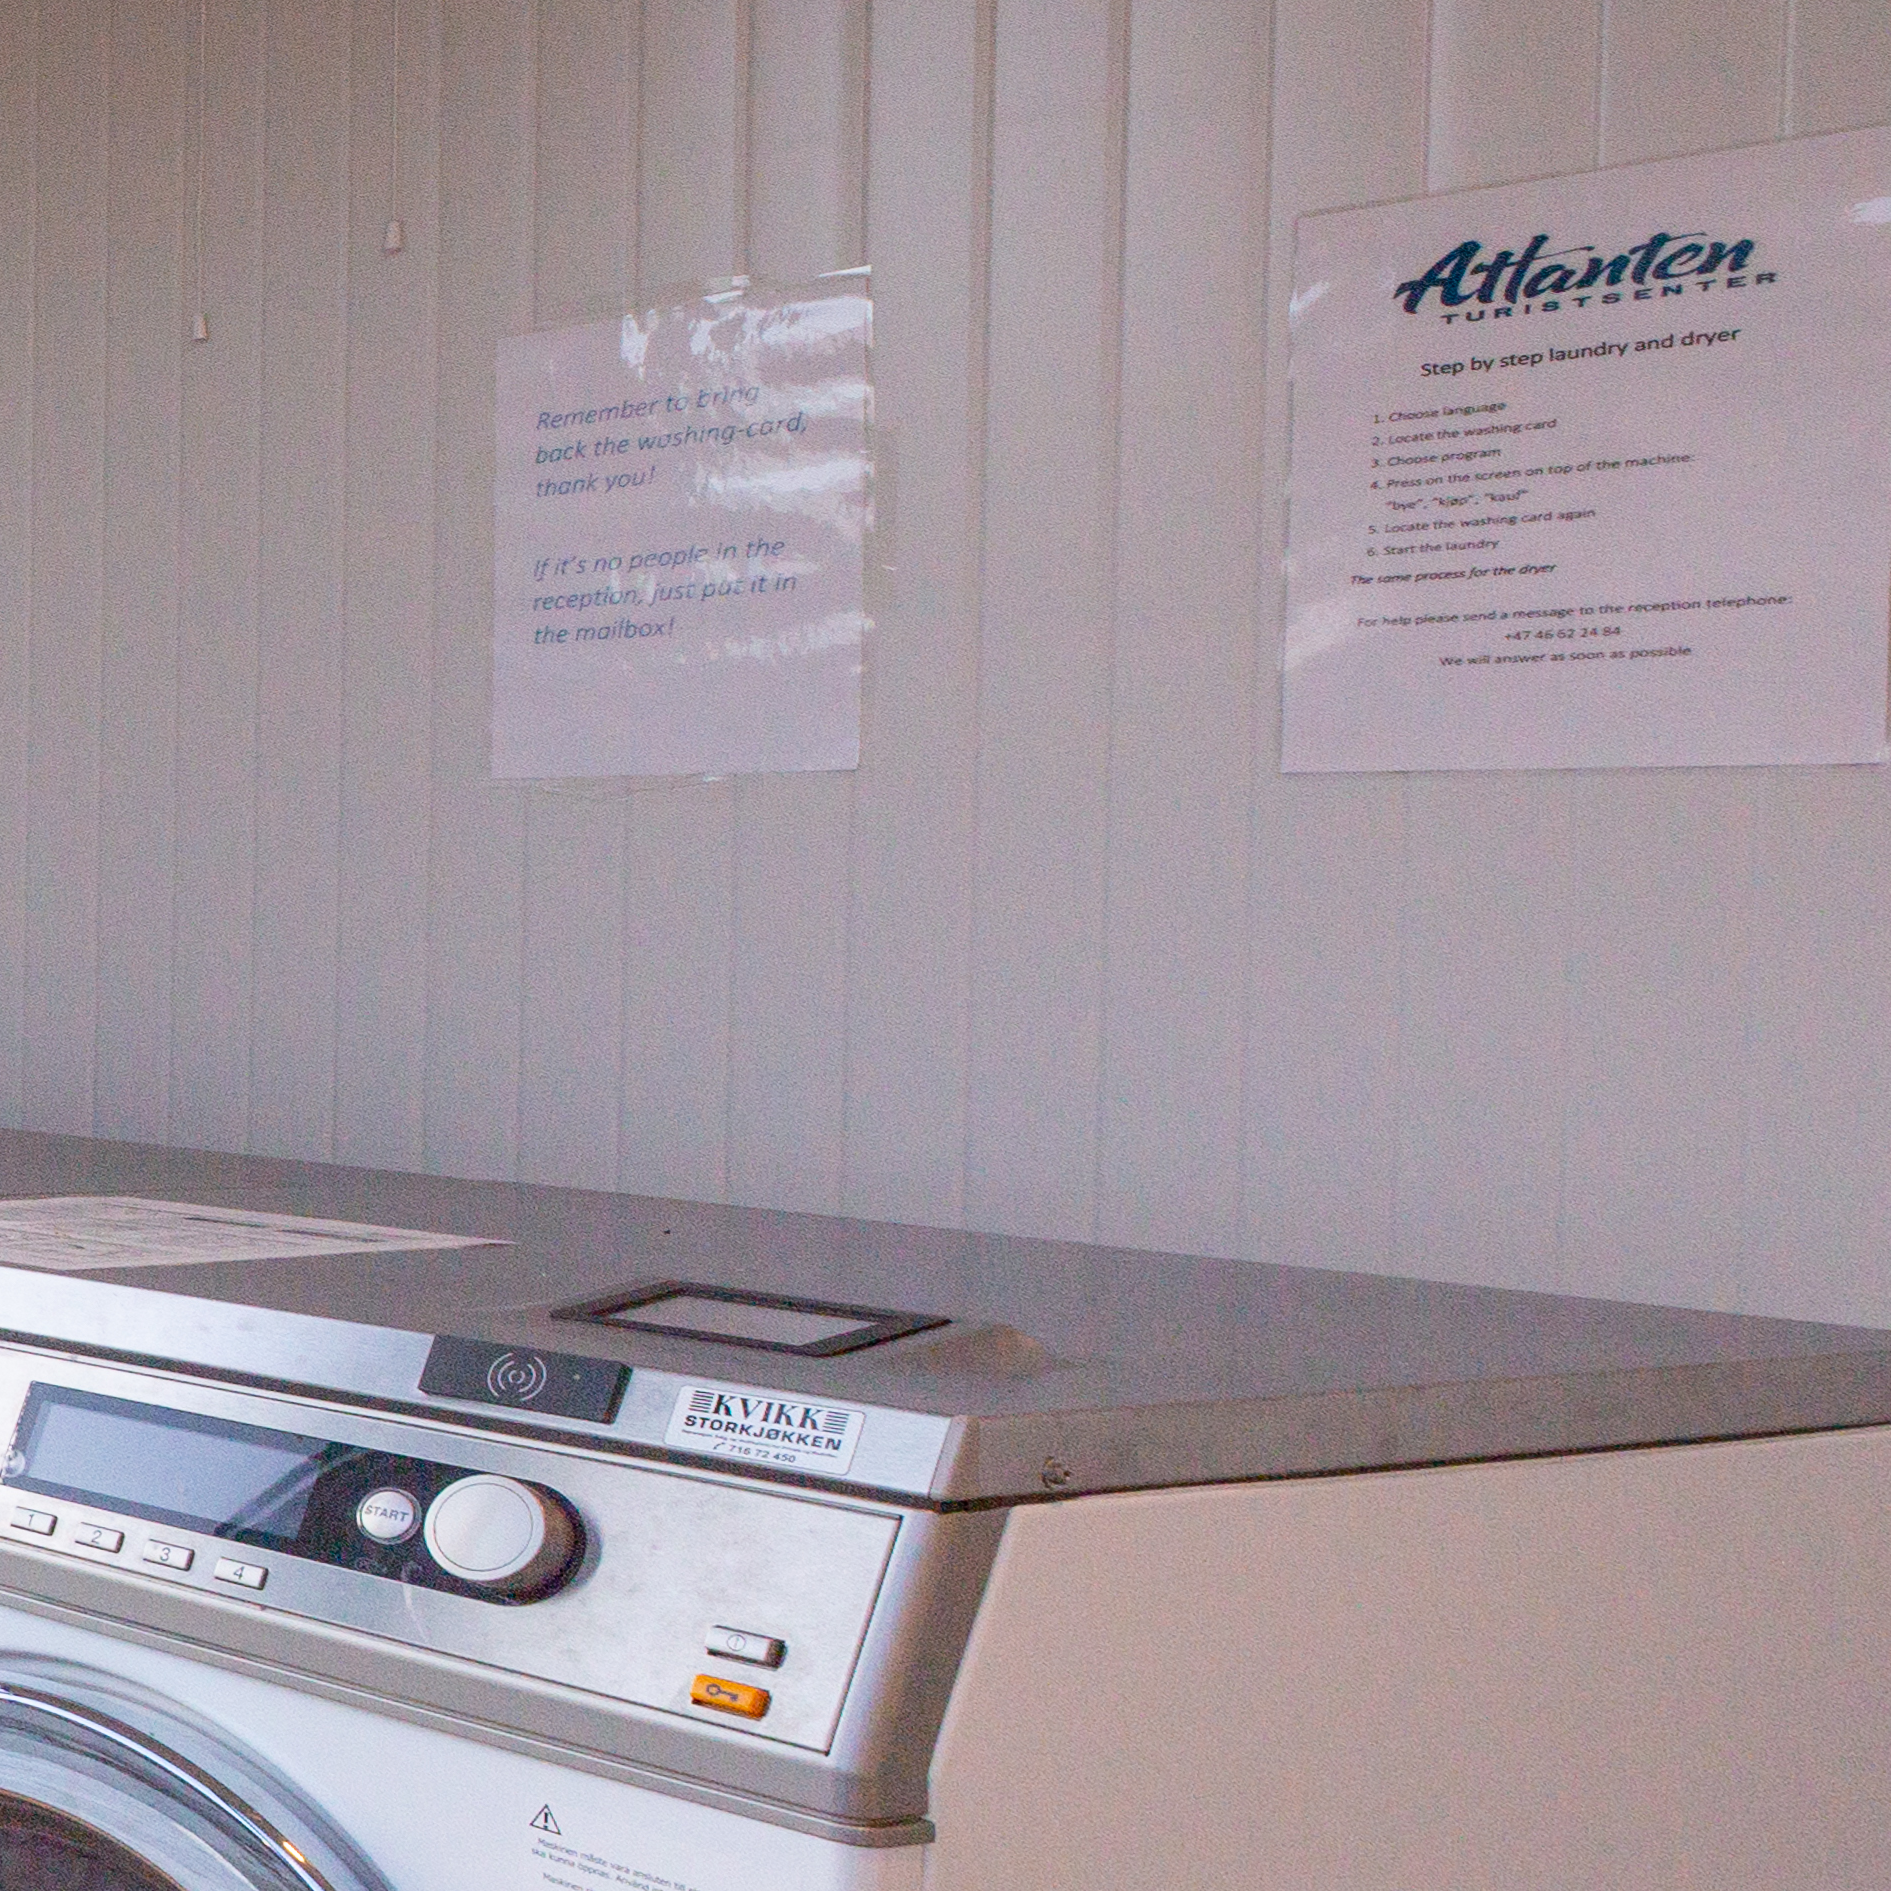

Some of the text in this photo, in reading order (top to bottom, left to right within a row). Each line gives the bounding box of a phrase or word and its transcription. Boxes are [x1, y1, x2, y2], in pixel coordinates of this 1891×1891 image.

[1393, 232, 1755, 314] Atlanten
[1440, 272, 1777, 324] TURISTSENTER
[1420, 327, 1742, 377] Step by step laundry and dryer
[537, 385, 760, 431] Remember to bring
[1373, 402, 1507, 424] 1. Choose language
[1372, 419, 1557, 447] 2. Locate the washing card
[536, 442, 587, 465] back
[593, 435, 629, 457] the
[1371, 448, 1502, 468] 3. Choose program
[537, 465, 656, 498] thank you!
[1370, 480, 1382, 490] 4.
[1387, 478, 1421, 488] Press
[1426, 477, 1442, 487] on
[1448, 474, 1470, 483] the
[1475, 469, 1521, 481] screen
[1525, 467, 1543, 477] on
[1548, 465, 1572, 477] top
[1576, 461, 1592, 472] of
[1595, 459, 1620, 470] the
[1369, 508, 1596, 535] 5. Locate the washing card again
[533, 538, 785, 582] If it's no people in the
[1367, 539, 1500, 557] 6. Start the laundry
[1351, 564, 1557, 585] The same process for the dryer
[648, 580, 695, 608] just
[701, 579, 742, 601] put
[749, 575, 767, 594] it
[775, 572, 798, 593] in
[1357, 616, 1378, 627] For
[1382, 615, 1412, 627] help
[1415, 613, 1459, 626] please
[1462, 610, 1497, 622] send
[1500, 611, 1509, 620] a
[1512, 607, 1575, 621] message
[1579, 605, 1594, 616] to
[1599, 604, 1623, 614] the
[1628, 600, 1701, 613] reception
[533, 616, 676, 645] the mailbox!
[1439, 646, 1692, 666] We will answer as soon as possible
[712, 1393, 824, 1431] KVIKK
[684, 1414, 842, 1451] STORKJØKKEN
[729, 1444, 797, 1464] 716 72 450
[28, 1514, 35, 1526] 1
[364, 1505, 410, 1522] START
[91, 1530, 103, 1545] 2
[160, 1547, 170, 1562] 3
[233, 1566, 245, 1580] 4
